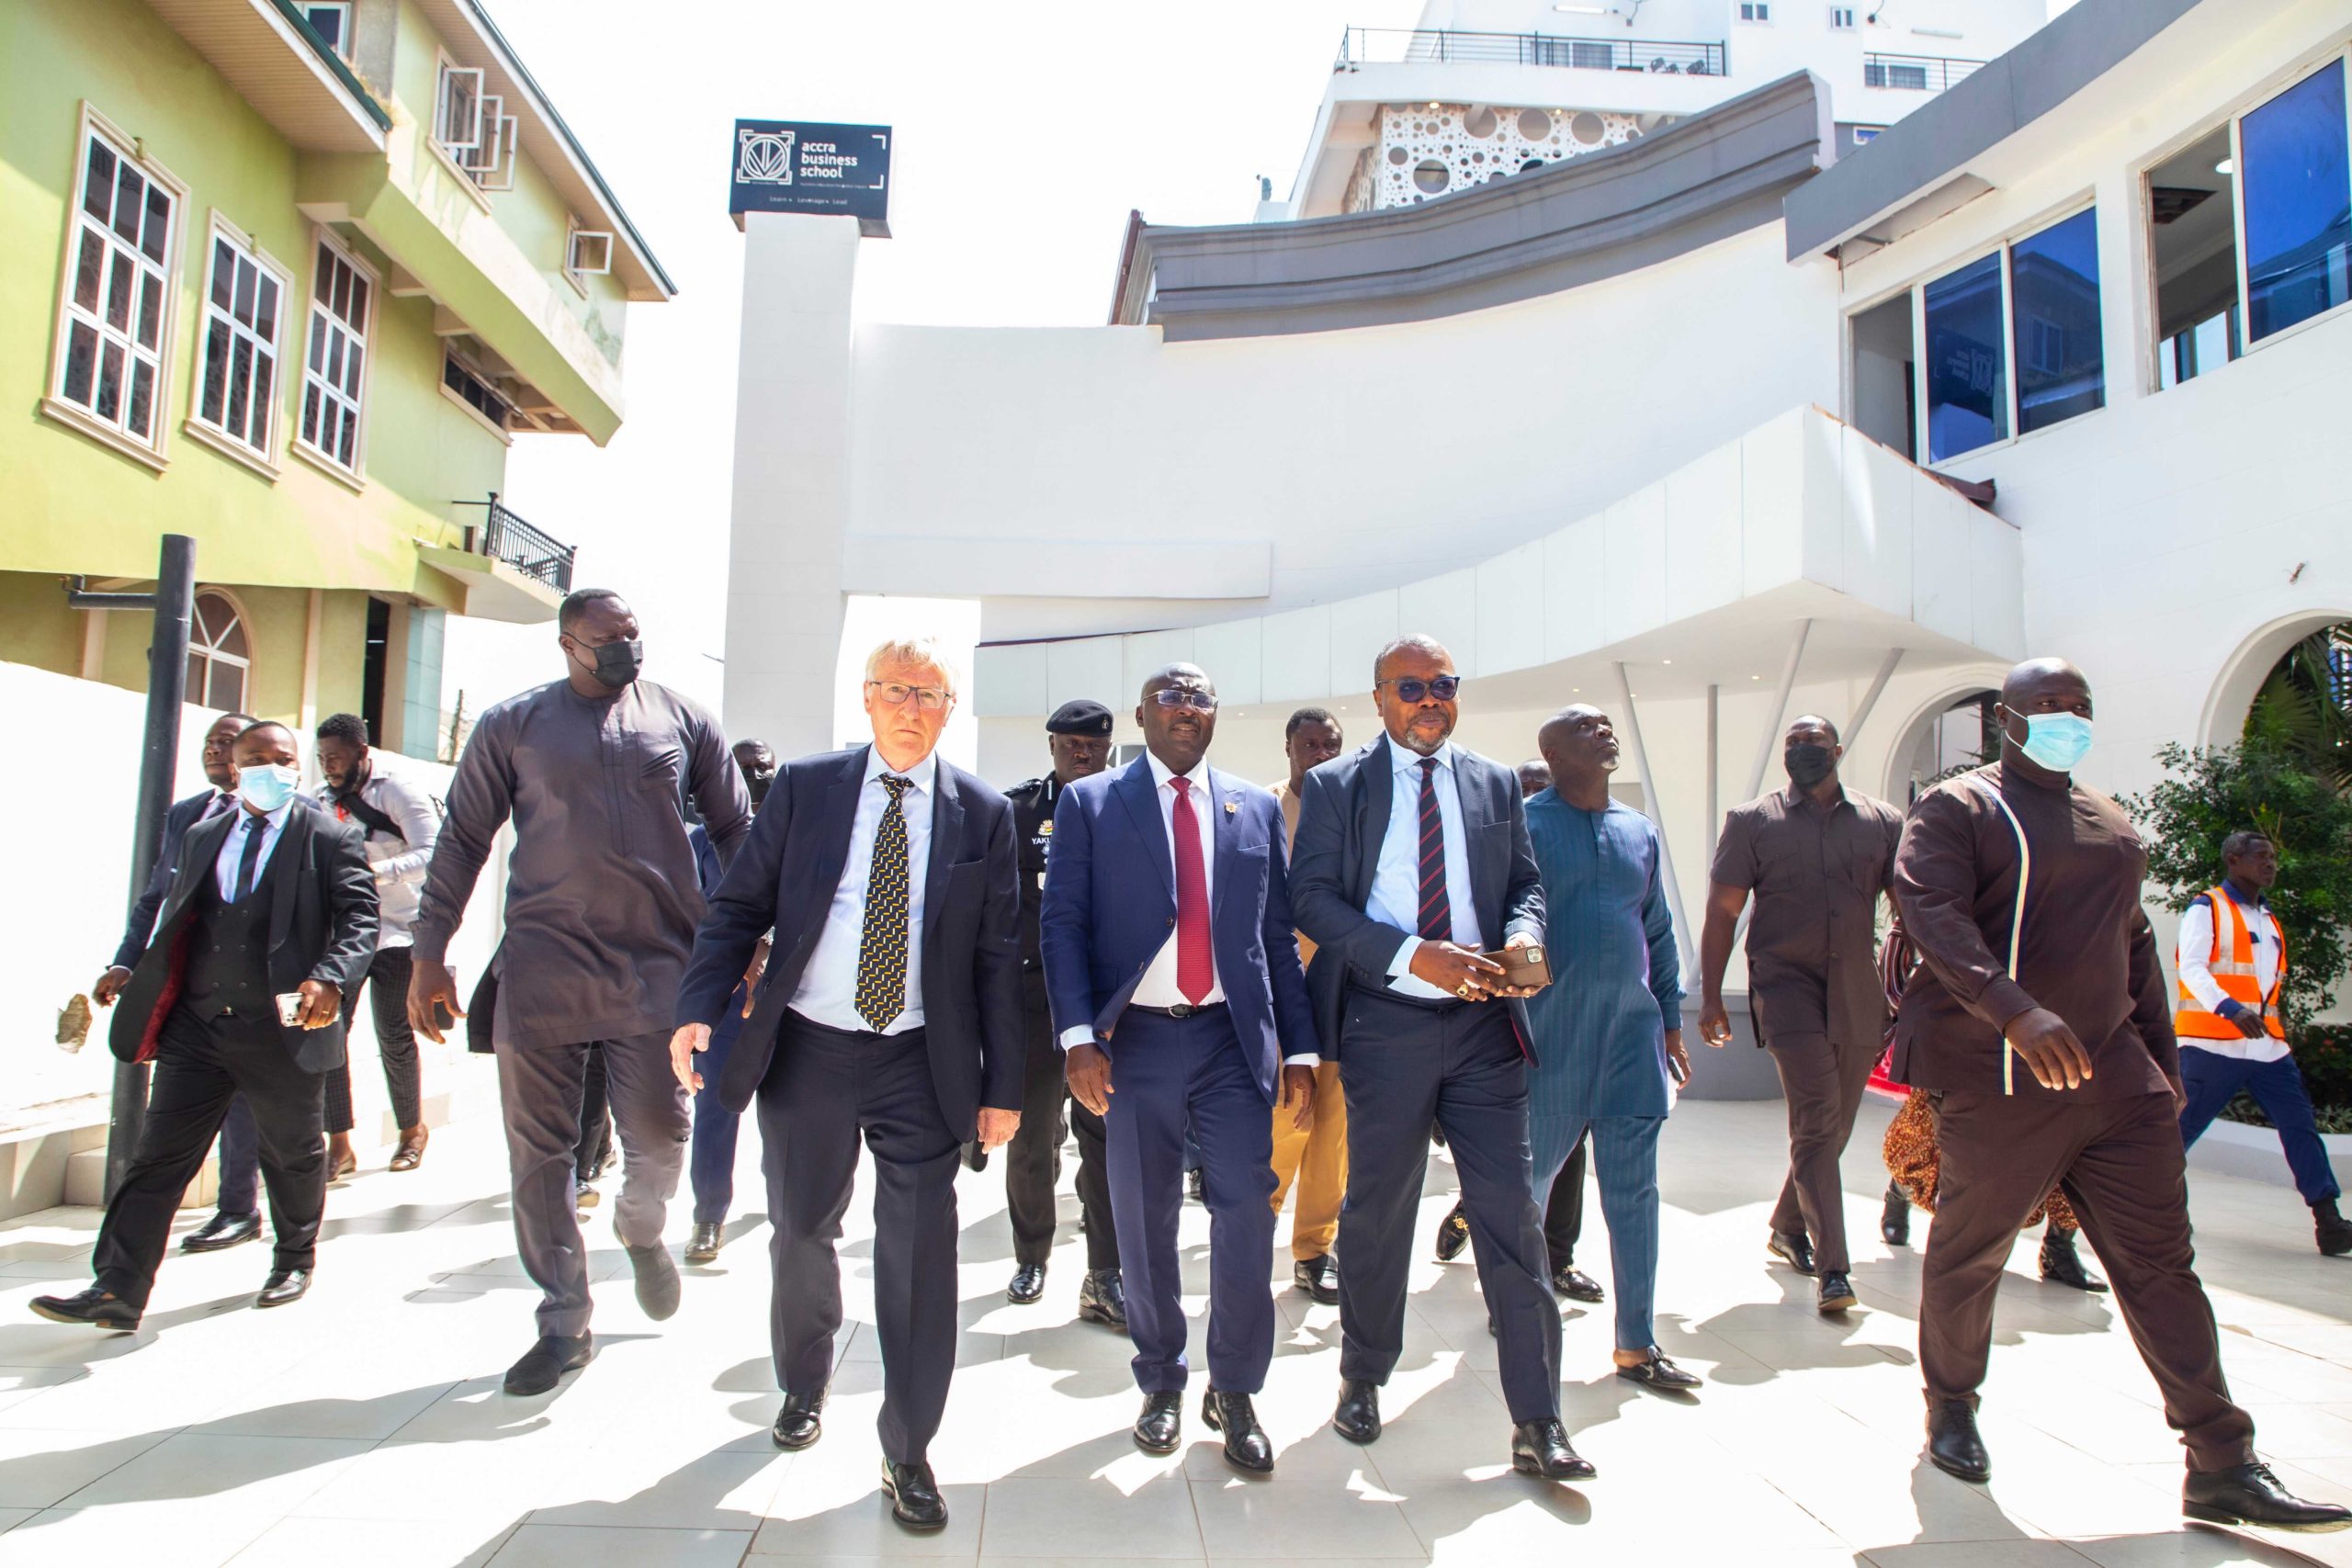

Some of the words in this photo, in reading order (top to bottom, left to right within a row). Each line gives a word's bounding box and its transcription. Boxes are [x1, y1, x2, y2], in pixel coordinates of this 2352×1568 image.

[801, 142, 836, 153] accra
[801, 152, 858, 166] business
[800, 165, 843, 178] school
